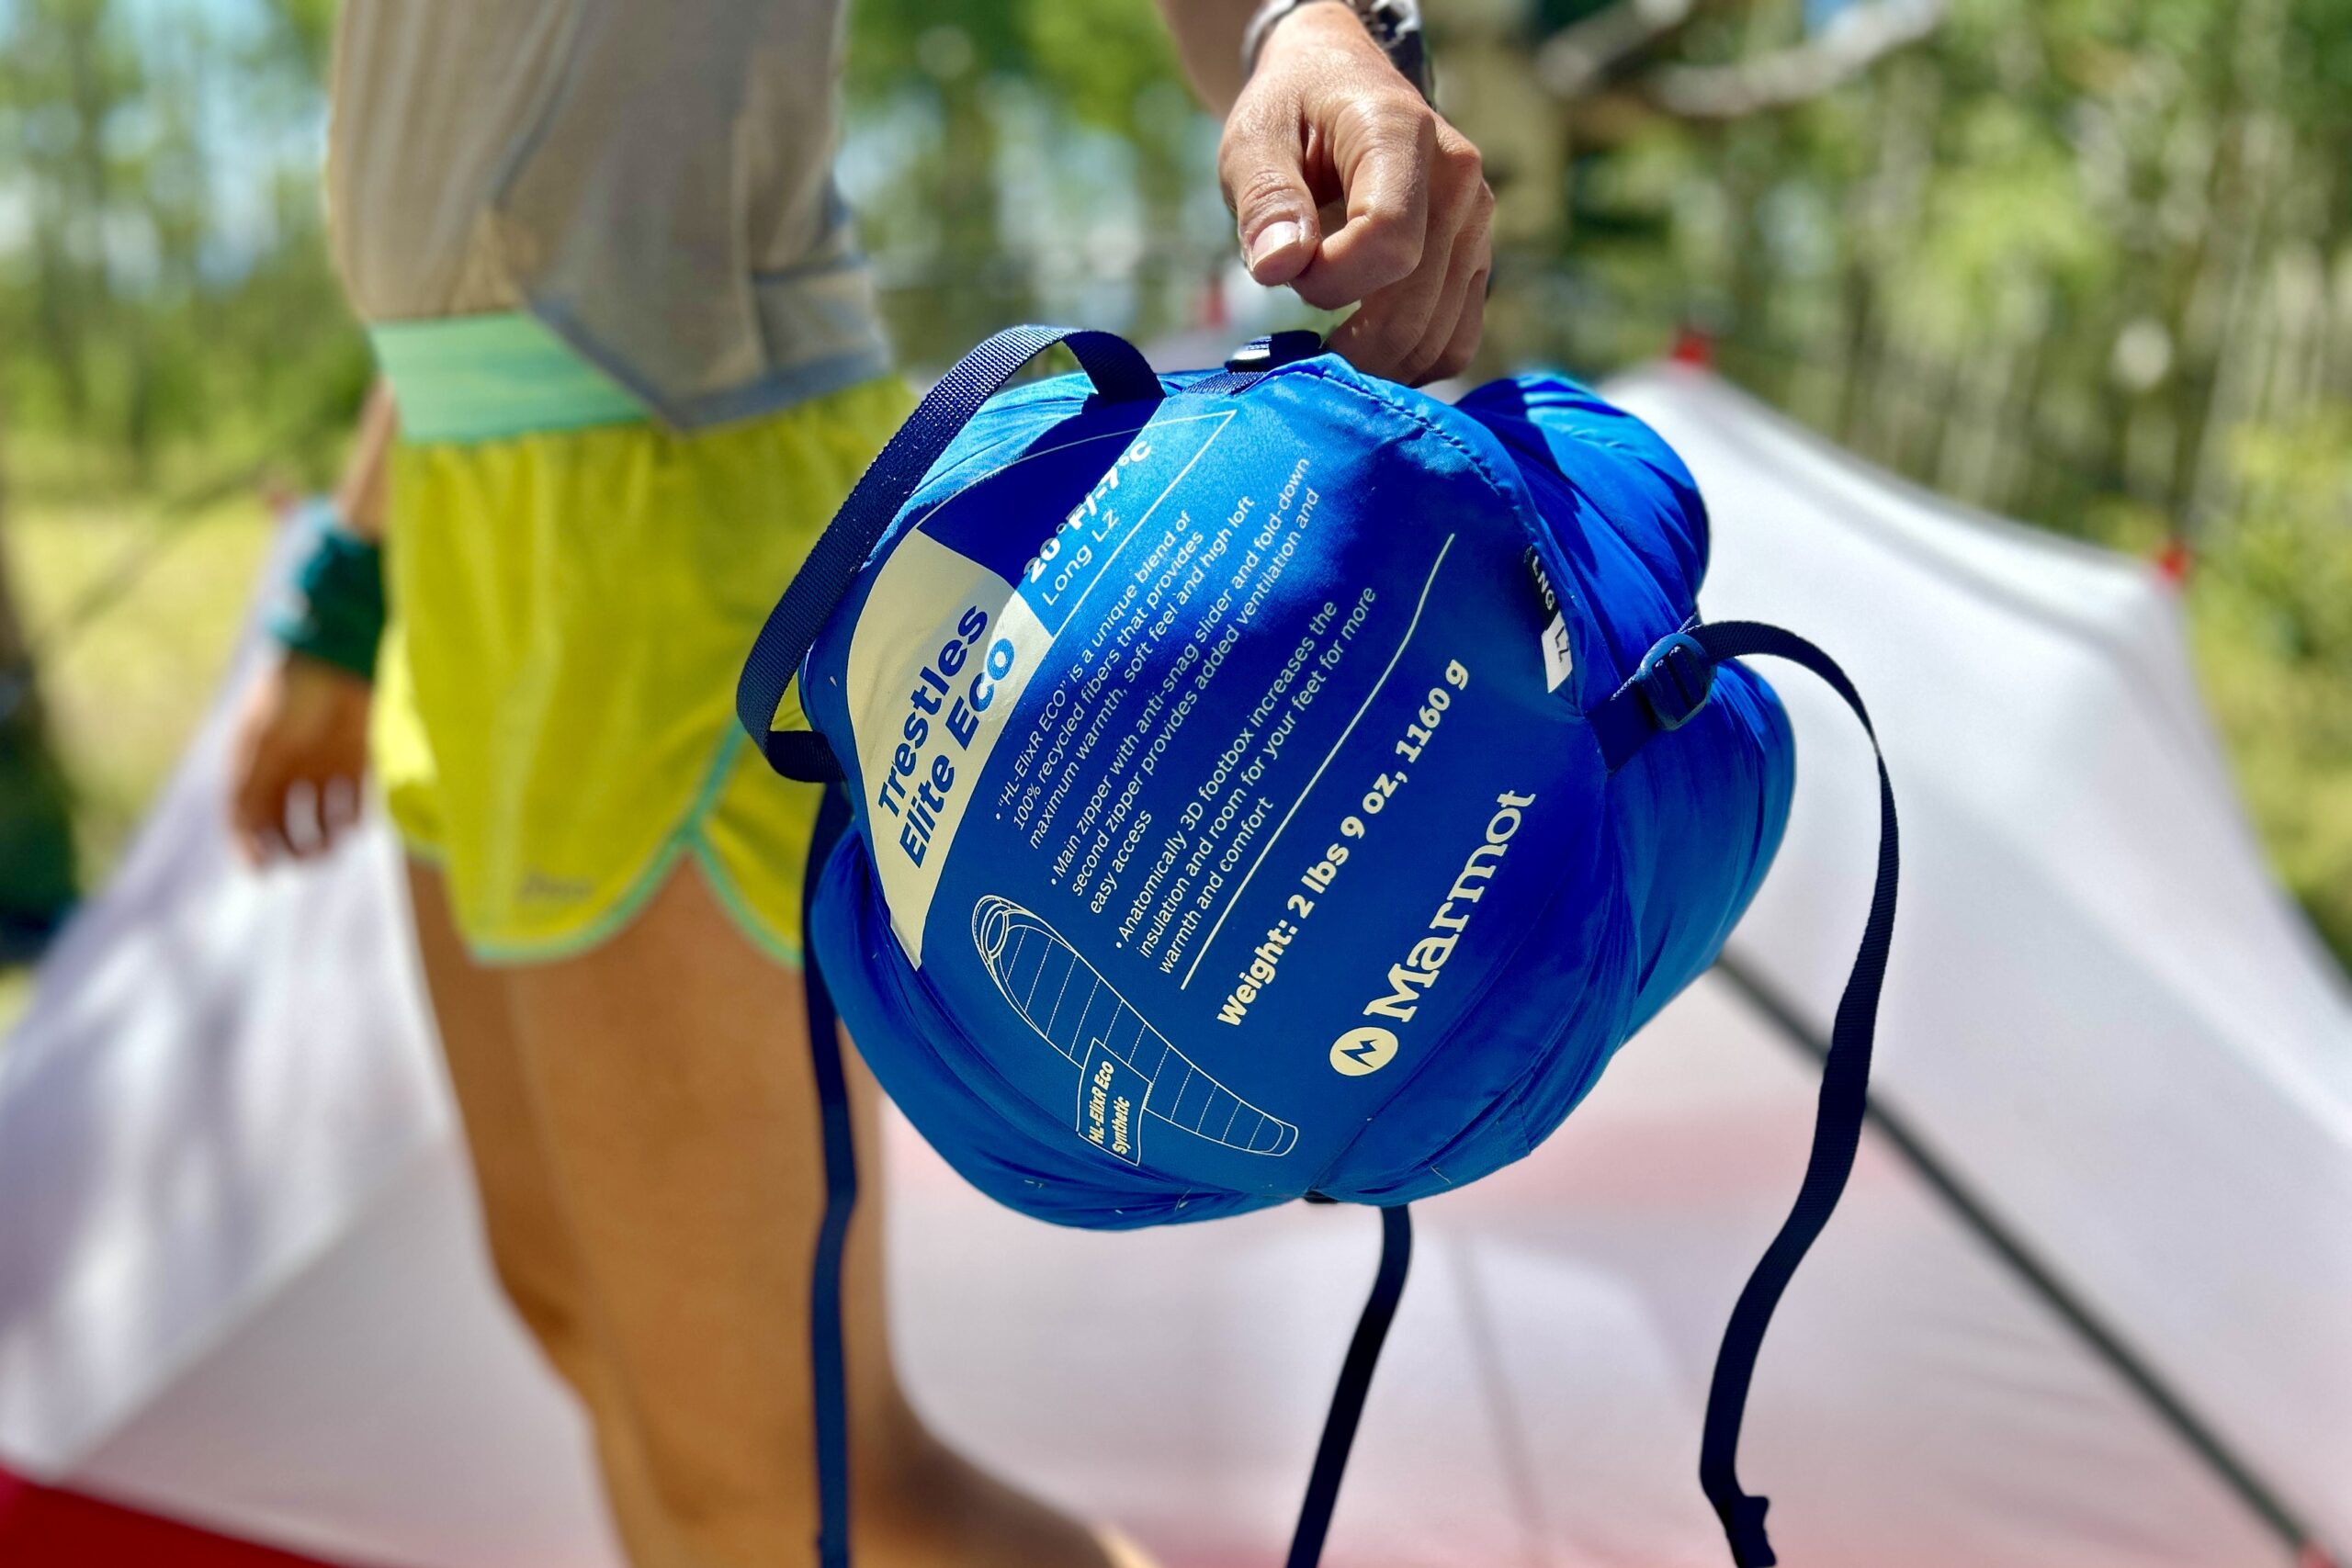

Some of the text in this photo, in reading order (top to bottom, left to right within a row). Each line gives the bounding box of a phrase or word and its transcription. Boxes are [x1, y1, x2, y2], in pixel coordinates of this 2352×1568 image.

[1028, 495, 1255, 850] maximum warmth, soft feel and high loft
[1041, 507, 1119, 606] Long LZ
[1052, 457, 1310, 878] Main zipper with anti-snag slider and fold-down
[1068, 662, 1083, 683] is
[1080, 648, 1094, 664] a
[1091, 582, 1137, 648] unique
[1133, 529, 1177, 584] blend
[1174, 509, 1191, 532] of
[1532, 555, 1556, 611] LNG
[877, 604, 989, 818] Trestles
[898, 637, 1015, 869] Elite Eco
[1012, 530, 1204, 830] 100% recycled fibers that provides
[1071, 486, 1319, 897] second zipper provides added ventilation and
[1117, 601, 1337, 942] Anatomically 3D footbox increases the
[1138, 586, 1375, 958] insulation and room for your feet for more
[1090, 809, 1152, 914] easy access
[1158, 795, 1273, 974] warmth and comfort
[1216, 658, 1469, 1026] Weight: 2 lbs 9 oz, 1160 g
[1362, 789, 1536, 1022] Marmot
[1087, 1059, 1114, 1145] HL-ElixR Eco
[1110, 1095, 1131, 1155] Synthetic
